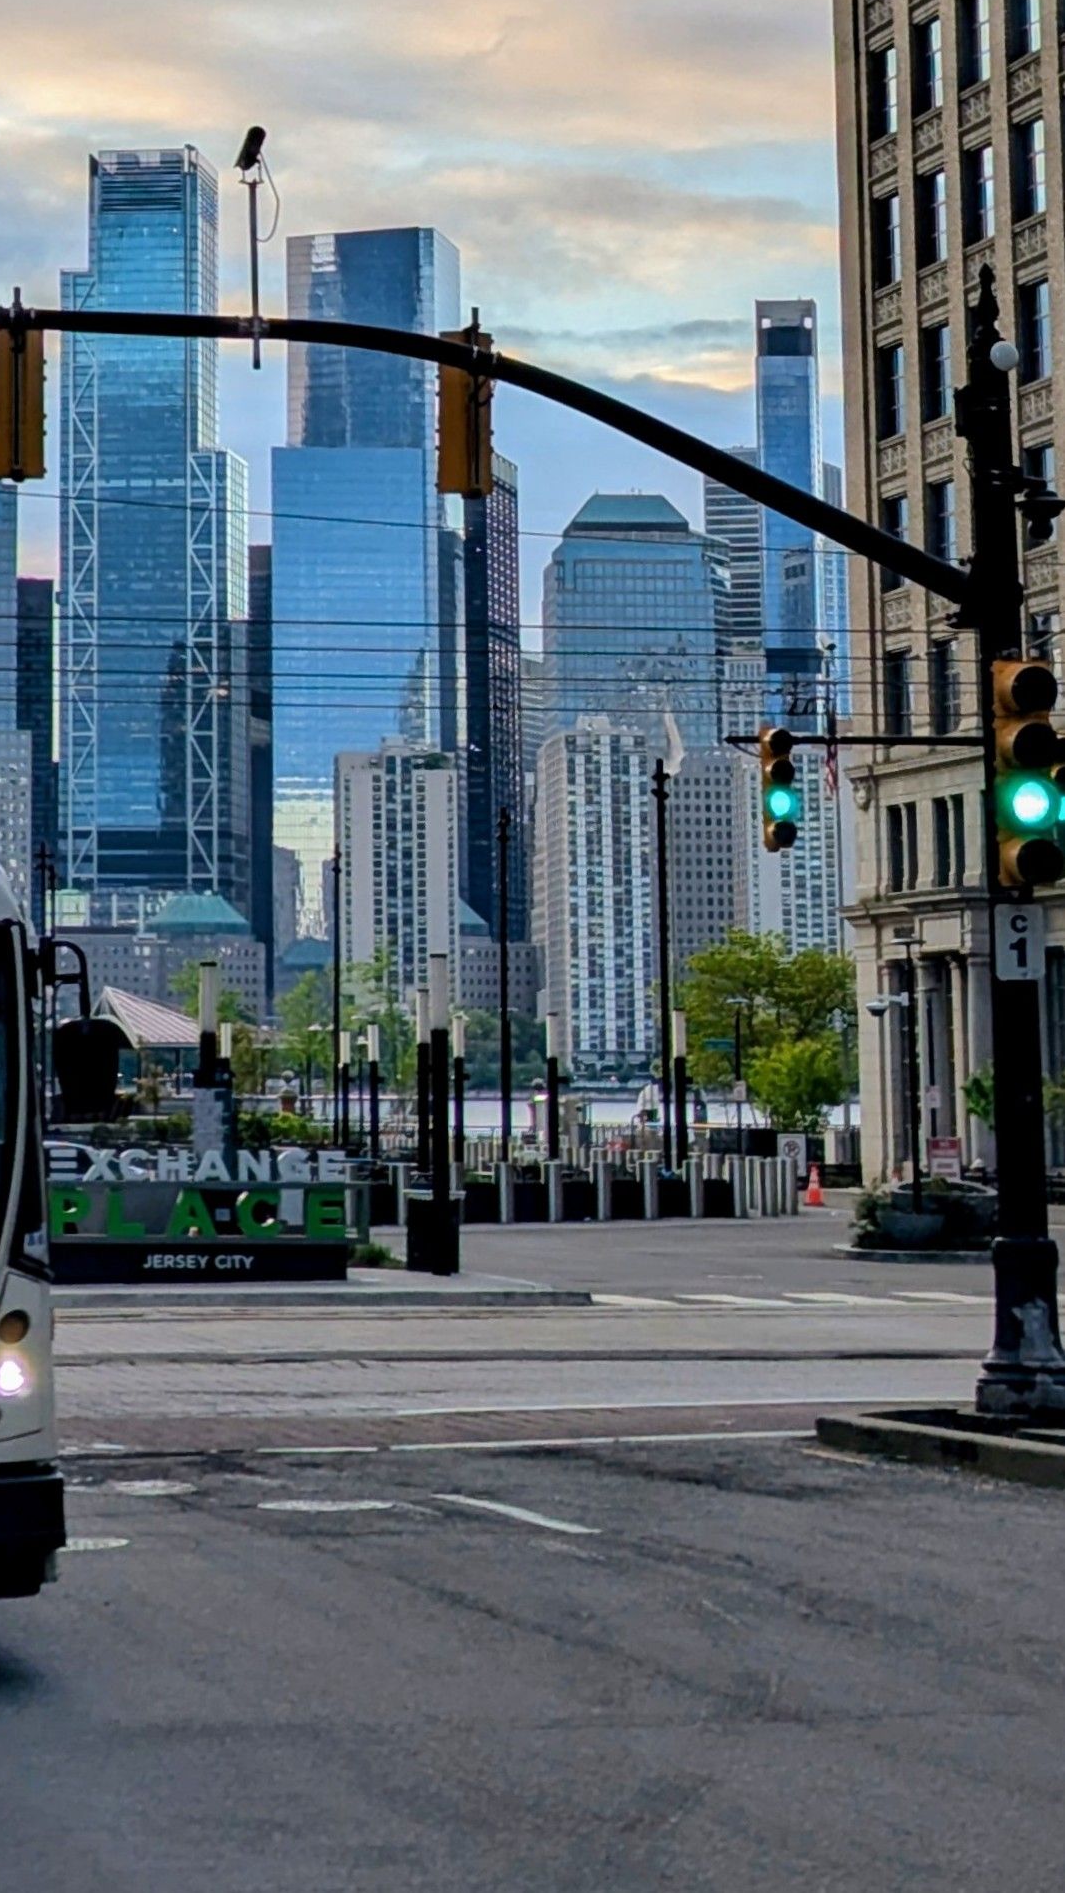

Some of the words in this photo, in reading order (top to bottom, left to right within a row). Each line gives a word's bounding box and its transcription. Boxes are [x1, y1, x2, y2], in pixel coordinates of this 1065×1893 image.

[1010, 914, 1028, 933] C
[1009, 937, 1027, 968] 1
[48, 1148, 346, 1182] EXCHANGE
[48, 1187, 346, 1237] PLACE
[143, 1254, 208, 1270] JERSEY
[215, 1254, 254, 1270] CITY
